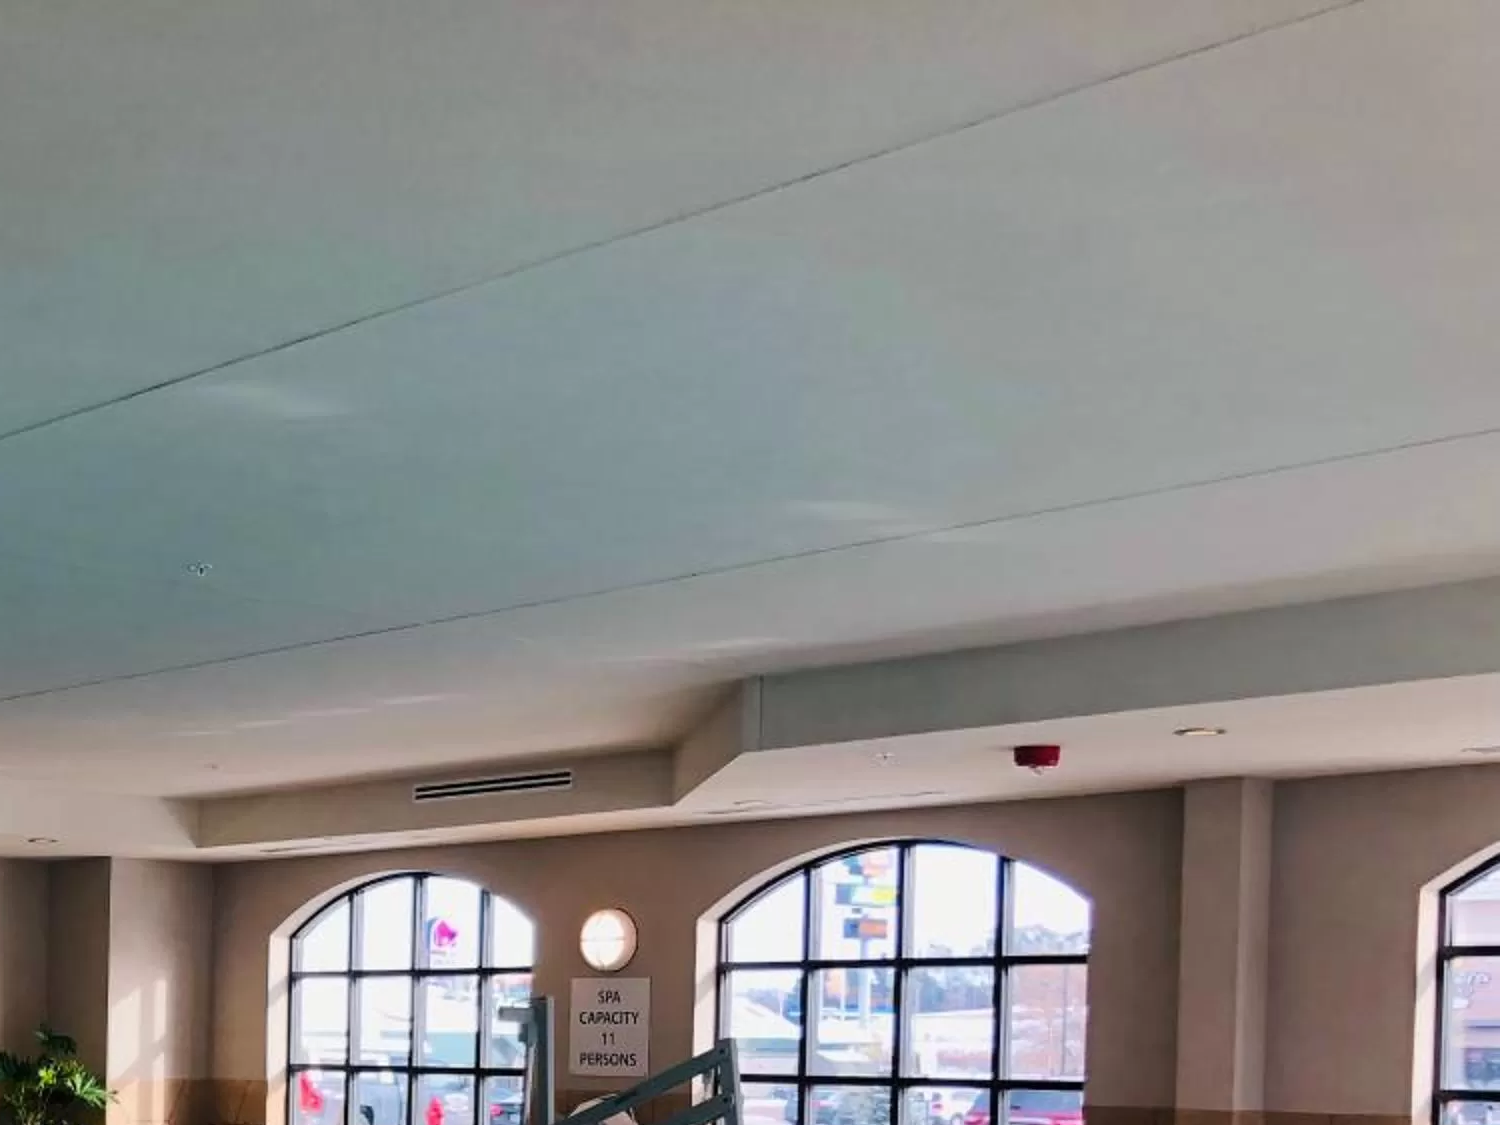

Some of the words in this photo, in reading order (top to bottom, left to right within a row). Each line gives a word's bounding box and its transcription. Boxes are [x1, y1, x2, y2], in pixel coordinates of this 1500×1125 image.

[597, 990, 621, 1004] SPA
[579, 1011, 639, 1025] CAPACITY
[601, 1032, 615, 1046] 11
[579, 1052, 637, 1066] PERSONS
